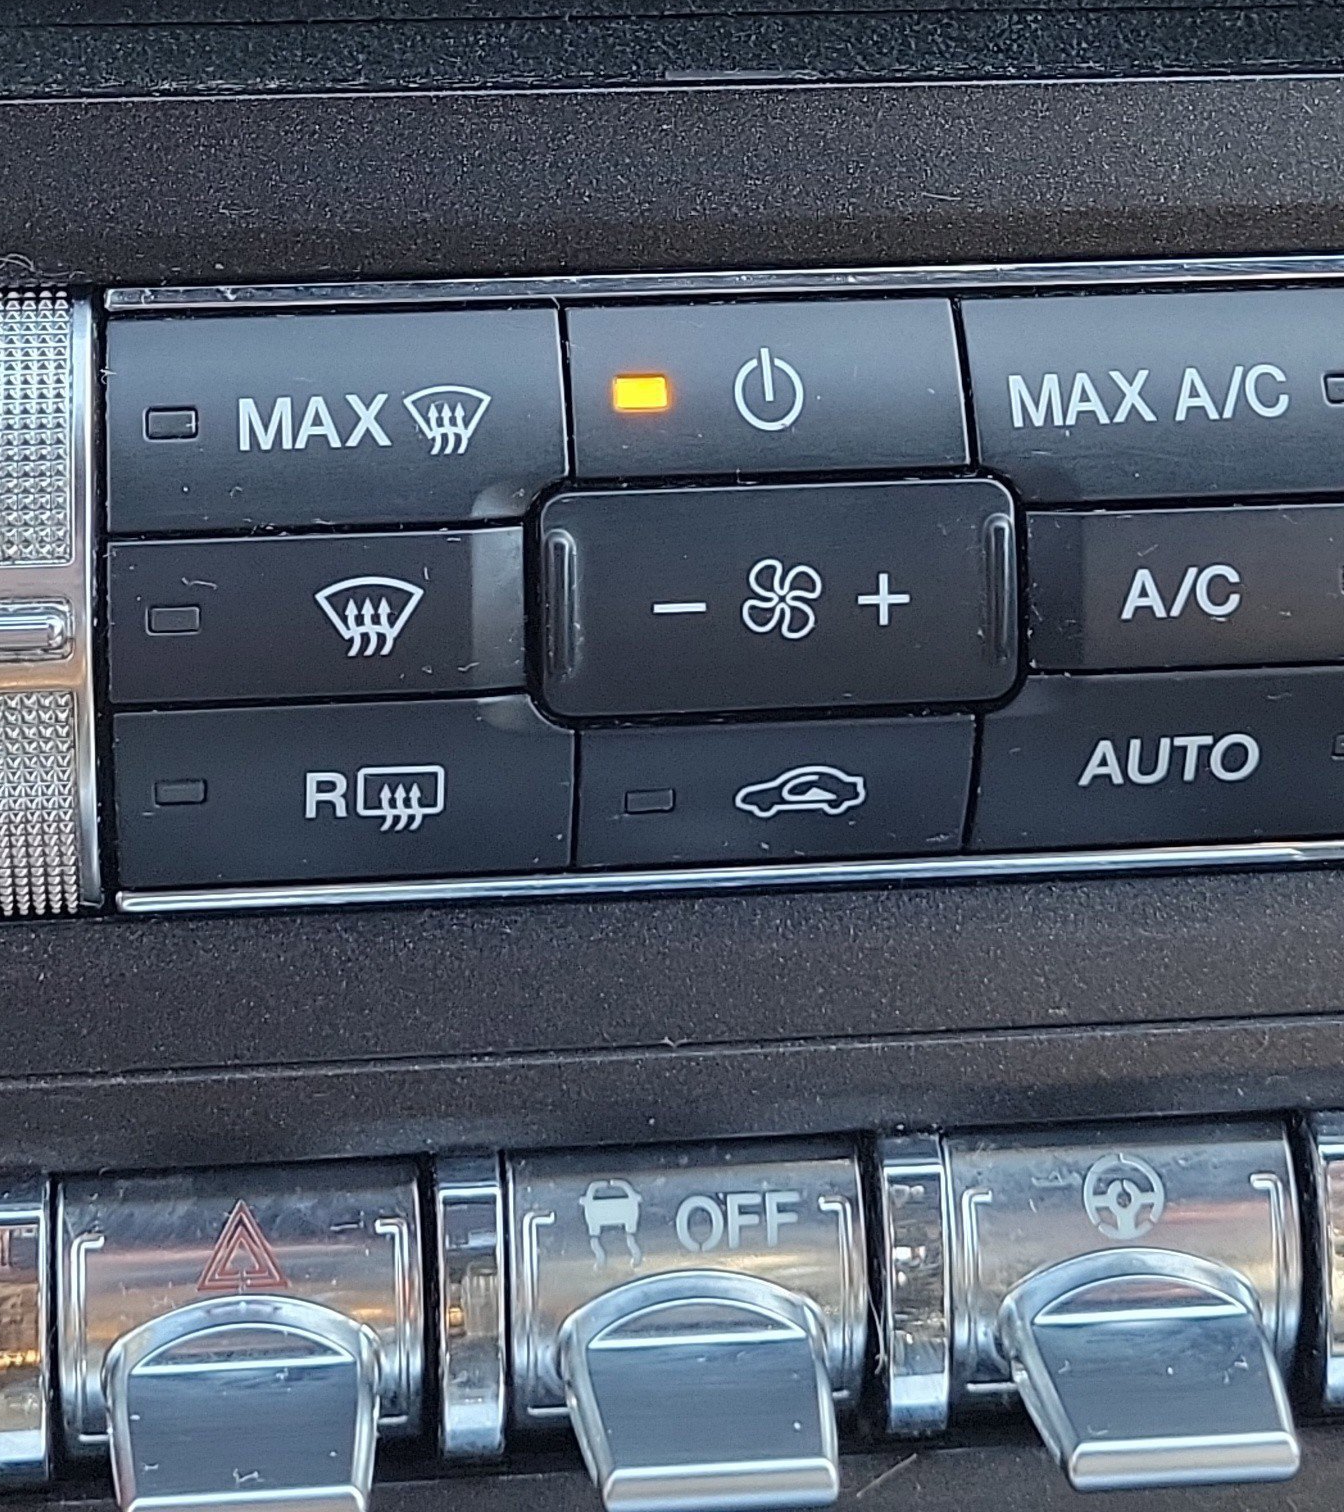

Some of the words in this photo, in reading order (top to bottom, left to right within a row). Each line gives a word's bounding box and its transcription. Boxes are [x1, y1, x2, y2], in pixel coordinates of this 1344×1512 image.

[238, 392, 392, 451] MAX
[1008, 369, 1157, 430] MAX
[1174, 364, 1291, 420] A/C
[1120, 564, 1242, 620] A/C
[1078, 733, 1260, 788] AUTO
[306, 773, 348, 819] R
[675, 1190, 799, 1254] OFF
